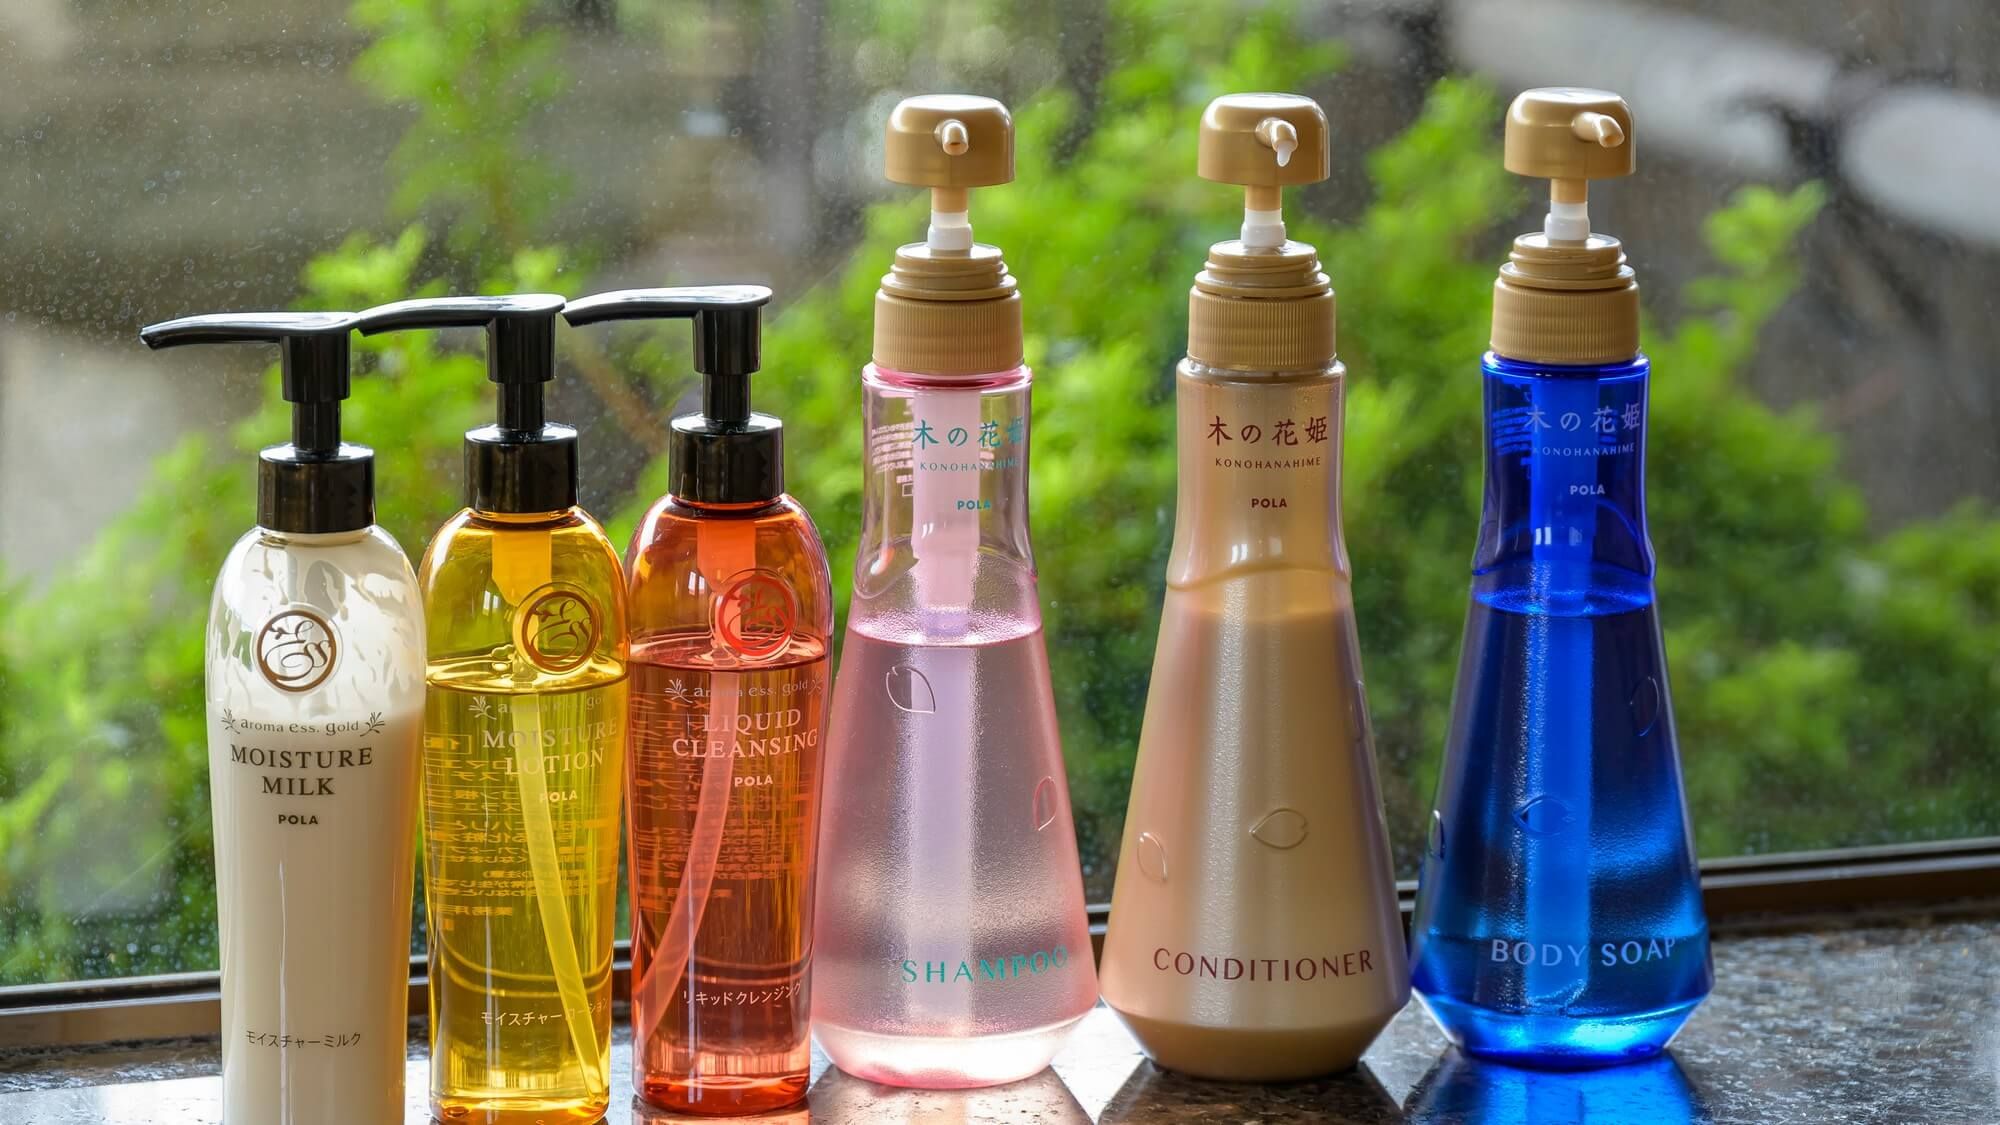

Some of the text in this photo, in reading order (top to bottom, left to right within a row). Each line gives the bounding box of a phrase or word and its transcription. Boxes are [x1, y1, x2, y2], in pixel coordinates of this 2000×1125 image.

[1523, 402, 1641, 433] 木の花姫
[1207, 415, 1328, 446] 木の花姫
[1531, 443, 1635, 457] ONOHANAHIME
[1215, 456, 1321, 470] KONOHANAHIME
[1569, 484, 1606, 496] POLA
[957, 499, 992, 511] POLA
[1251, 497, 1288, 509] POLA
[782, 679, 808, 696] gold
[240, 718, 359, 736] aroma ess. gold
[702, 708, 801, 735] LIQUID
[482, 717, 617, 749] MOISTURE
[672, 728, 818, 758] CLEANSING
[230, 744, 373, 769] MOISTURE
[504, 747, 605, 776] LOTION
[261, 775, 336, 796] MILK
[734, 774, 773, 788] POLA
[539, 789, 578, 803] POLA
[278, 814, 319, 825] POLA
[1490, 936, 1676, 967] BODY SOAP
[902, 944, 1068, 984] SHAMPOO
[1153, 947, 1374, 982] CONDITIONER
[245, 1030, 361, 1049] モイスチャーミルク
